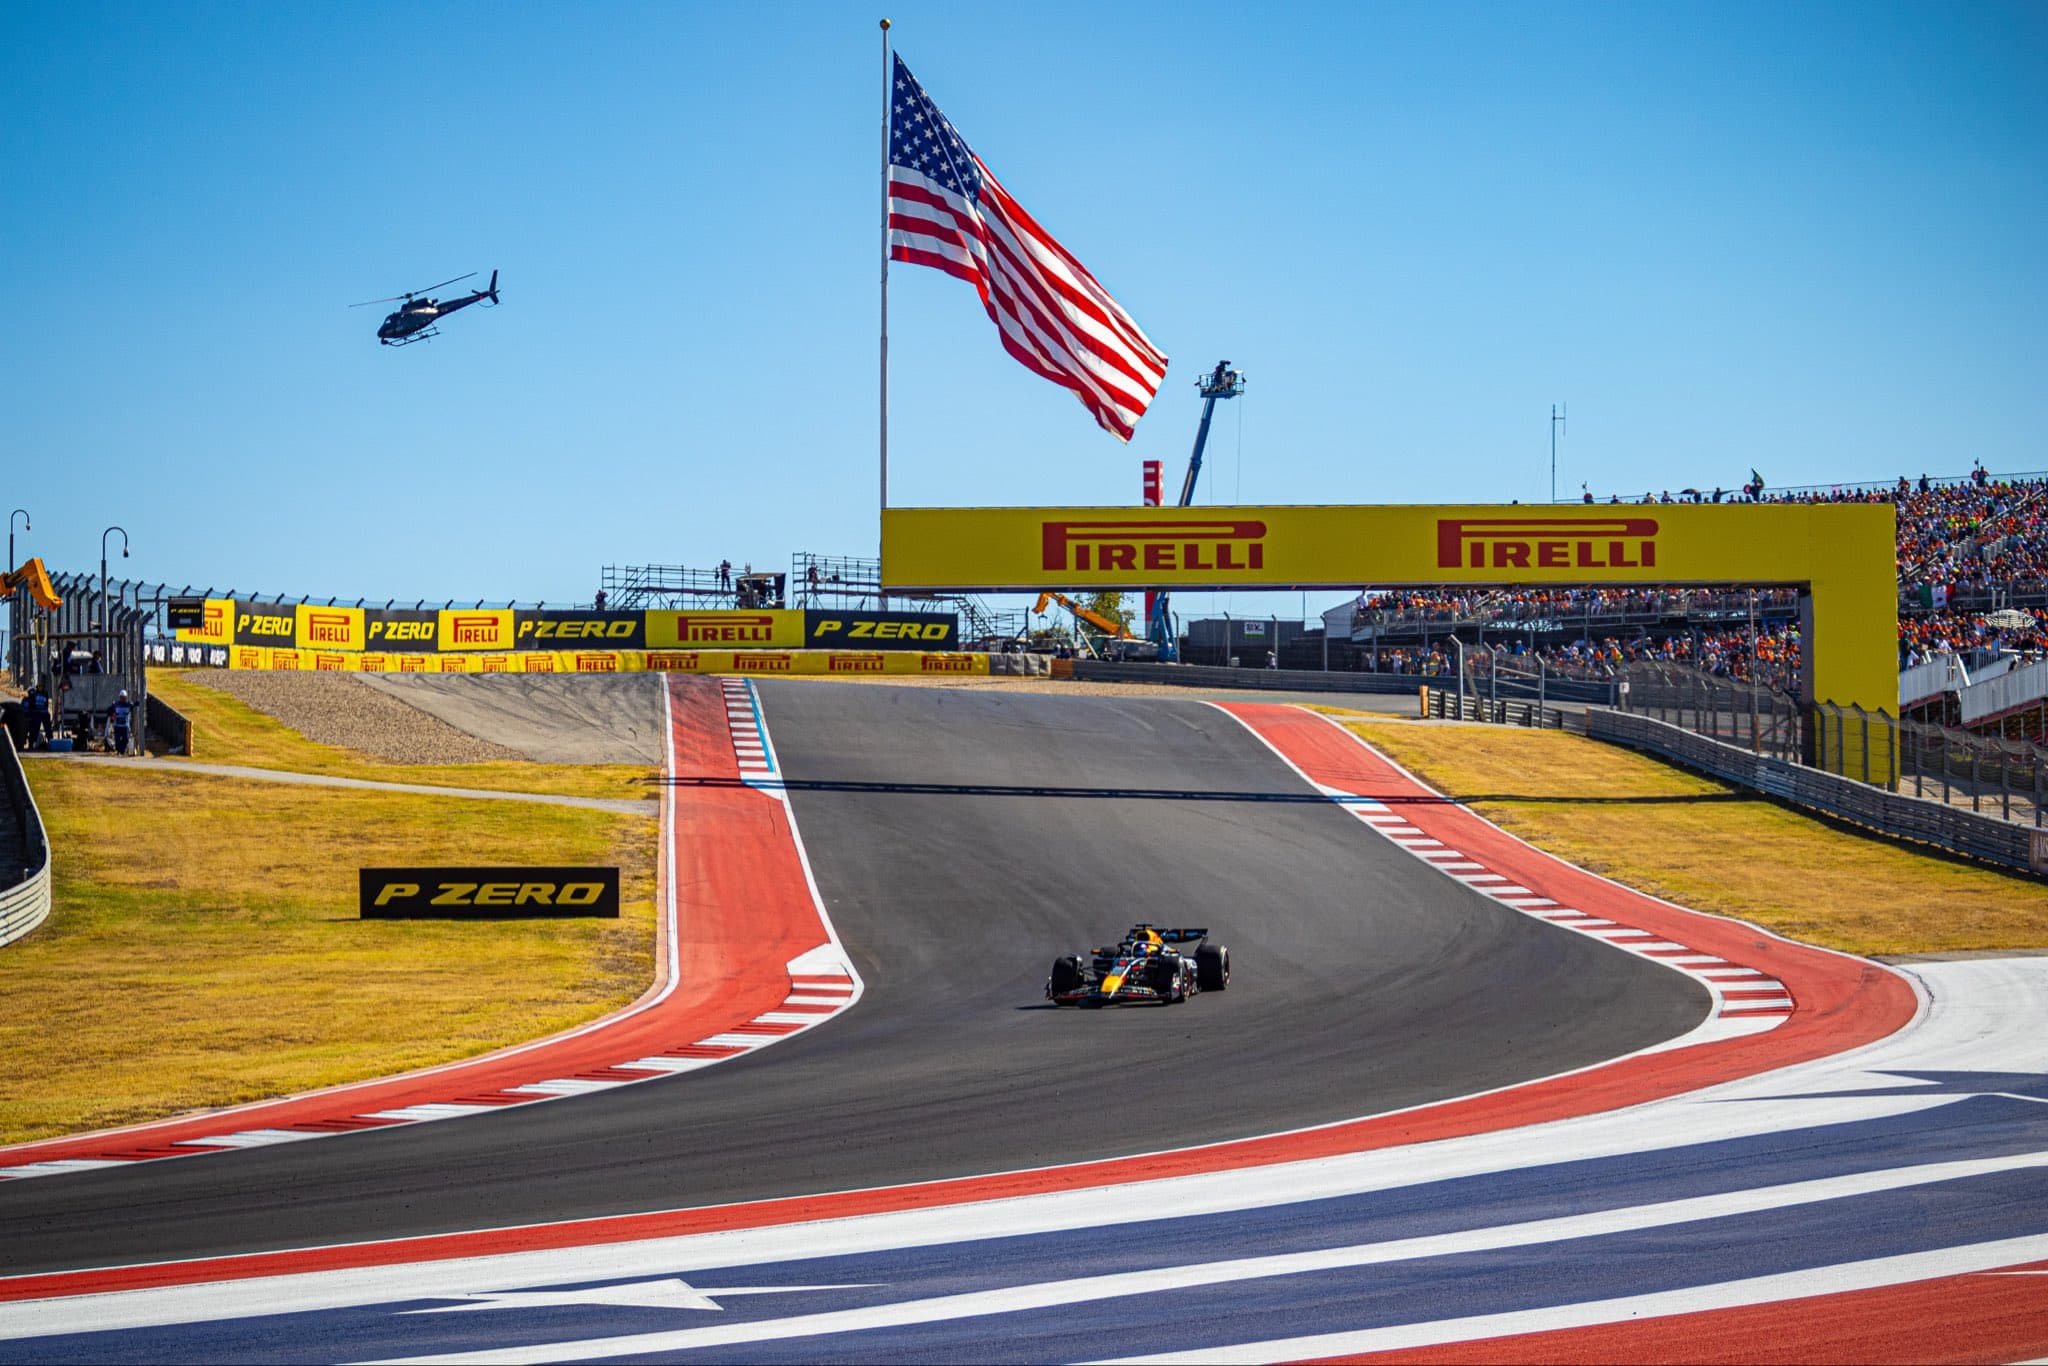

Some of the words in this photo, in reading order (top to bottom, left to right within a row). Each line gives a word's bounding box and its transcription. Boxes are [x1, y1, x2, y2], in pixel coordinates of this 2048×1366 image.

[1042, 520, 1267, 571] PIRELLI
[1437, 518, 1659, 568] PIRELLI
[237, 614, 250, 633] P
[251, 615, 293, 637] ZERO
[309, 613, 351, 643] PIRELLI
[368, 621, 383, 640] P
[384, 621, 435, 640] ZERO
[453, 617, 499, 643] PIRELLI
[518, 620, 534, 638] P
[534, 620, 637, 638] ZERO
[677, 616, 773, 641] PIRELLI
[814, 620, 842, 637] P
[847, 621, 950, 640] ZERO
[576, 653, 616, 671] PIRELLI
[646, 653, 699, 670] PIRELLI
[733, 654, 791, 671] PIRELLI
[829, 655, 884, 671] PIRELLI
[921, 655, 973, 671] PIRELLI
[374, 883, 420, 906] P
[430, 882, 605, 905] ZERO
